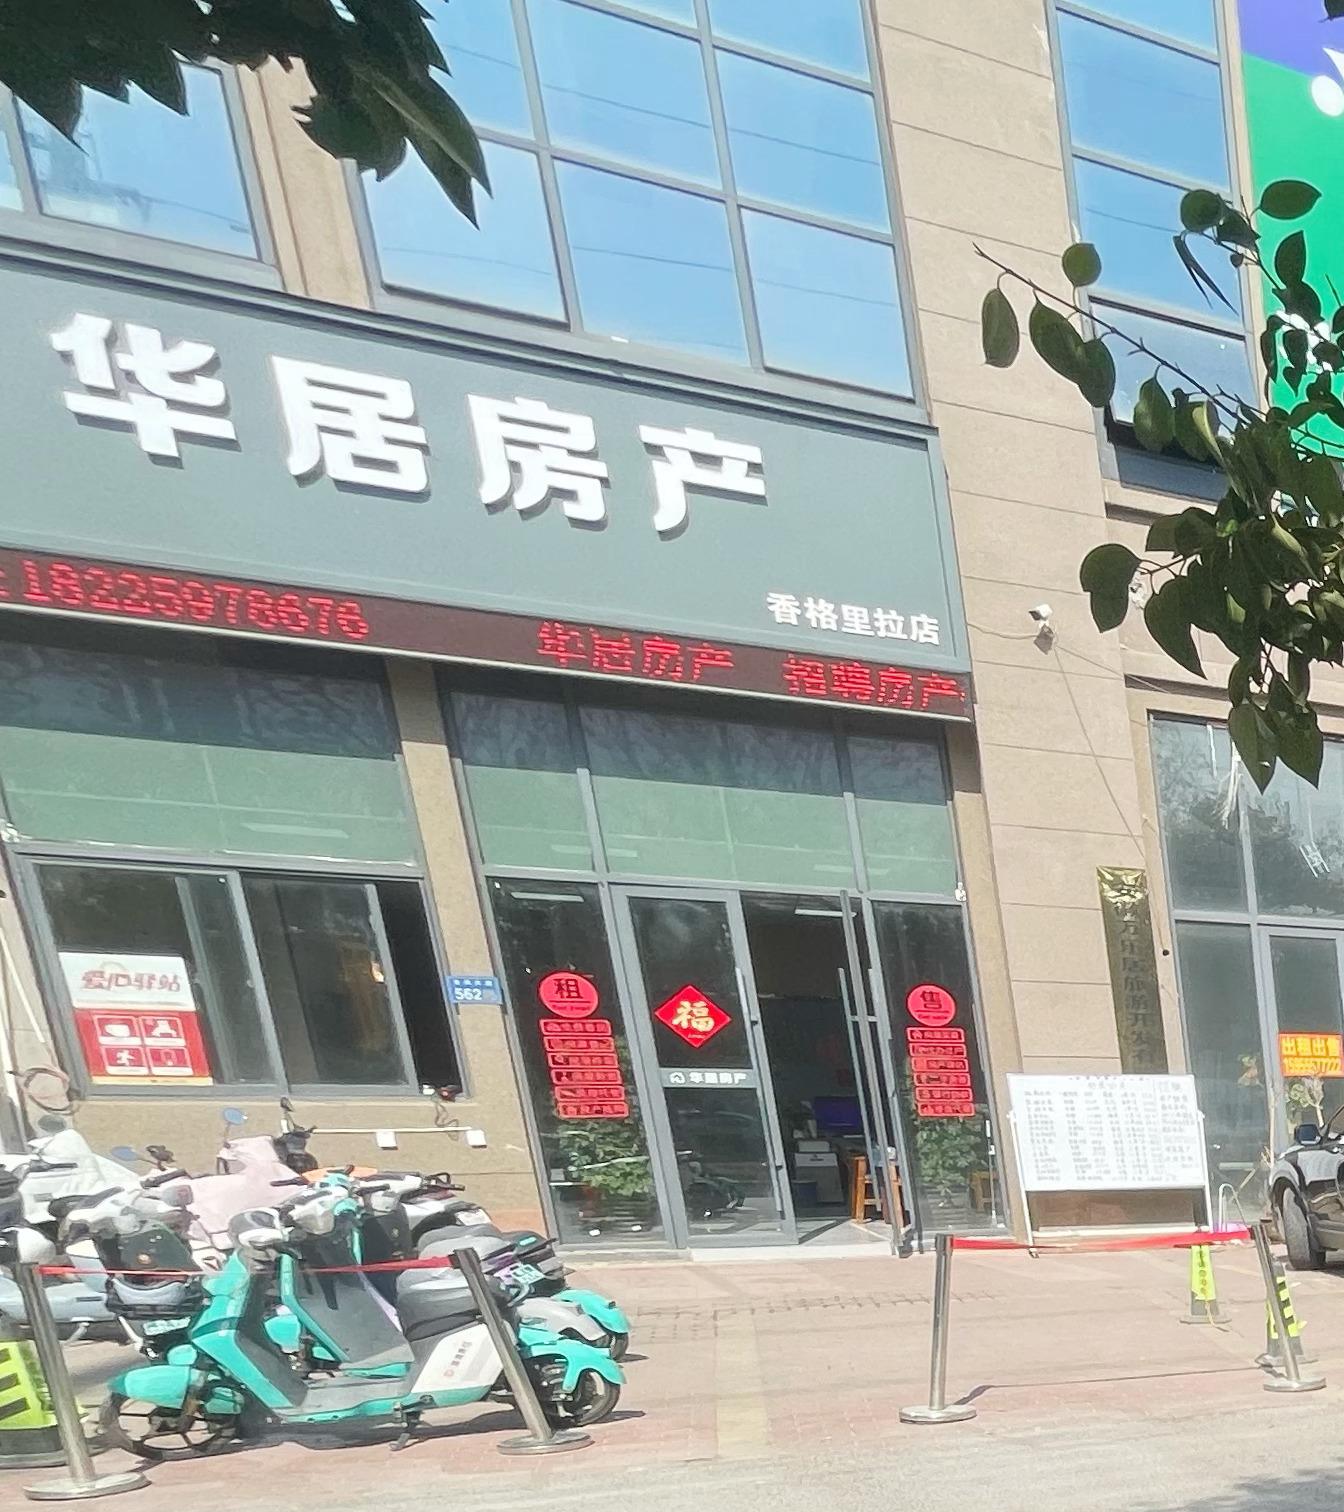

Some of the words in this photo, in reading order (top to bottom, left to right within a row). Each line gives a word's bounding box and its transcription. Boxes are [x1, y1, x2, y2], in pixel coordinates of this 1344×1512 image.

[51, 312, 767, 532] 华居房产
[766, 592, 941, 646] 香格里拉店
[535, 620, 735, 681] 华居房产
[454, 987, 483, 1001] 562
[553, 978, 583, 999] 租
[920, 991, 942, 1009] 售
[672, 1000, 715, 1032] 福
[1281, 1036, 1341, 1057] 出租出售
